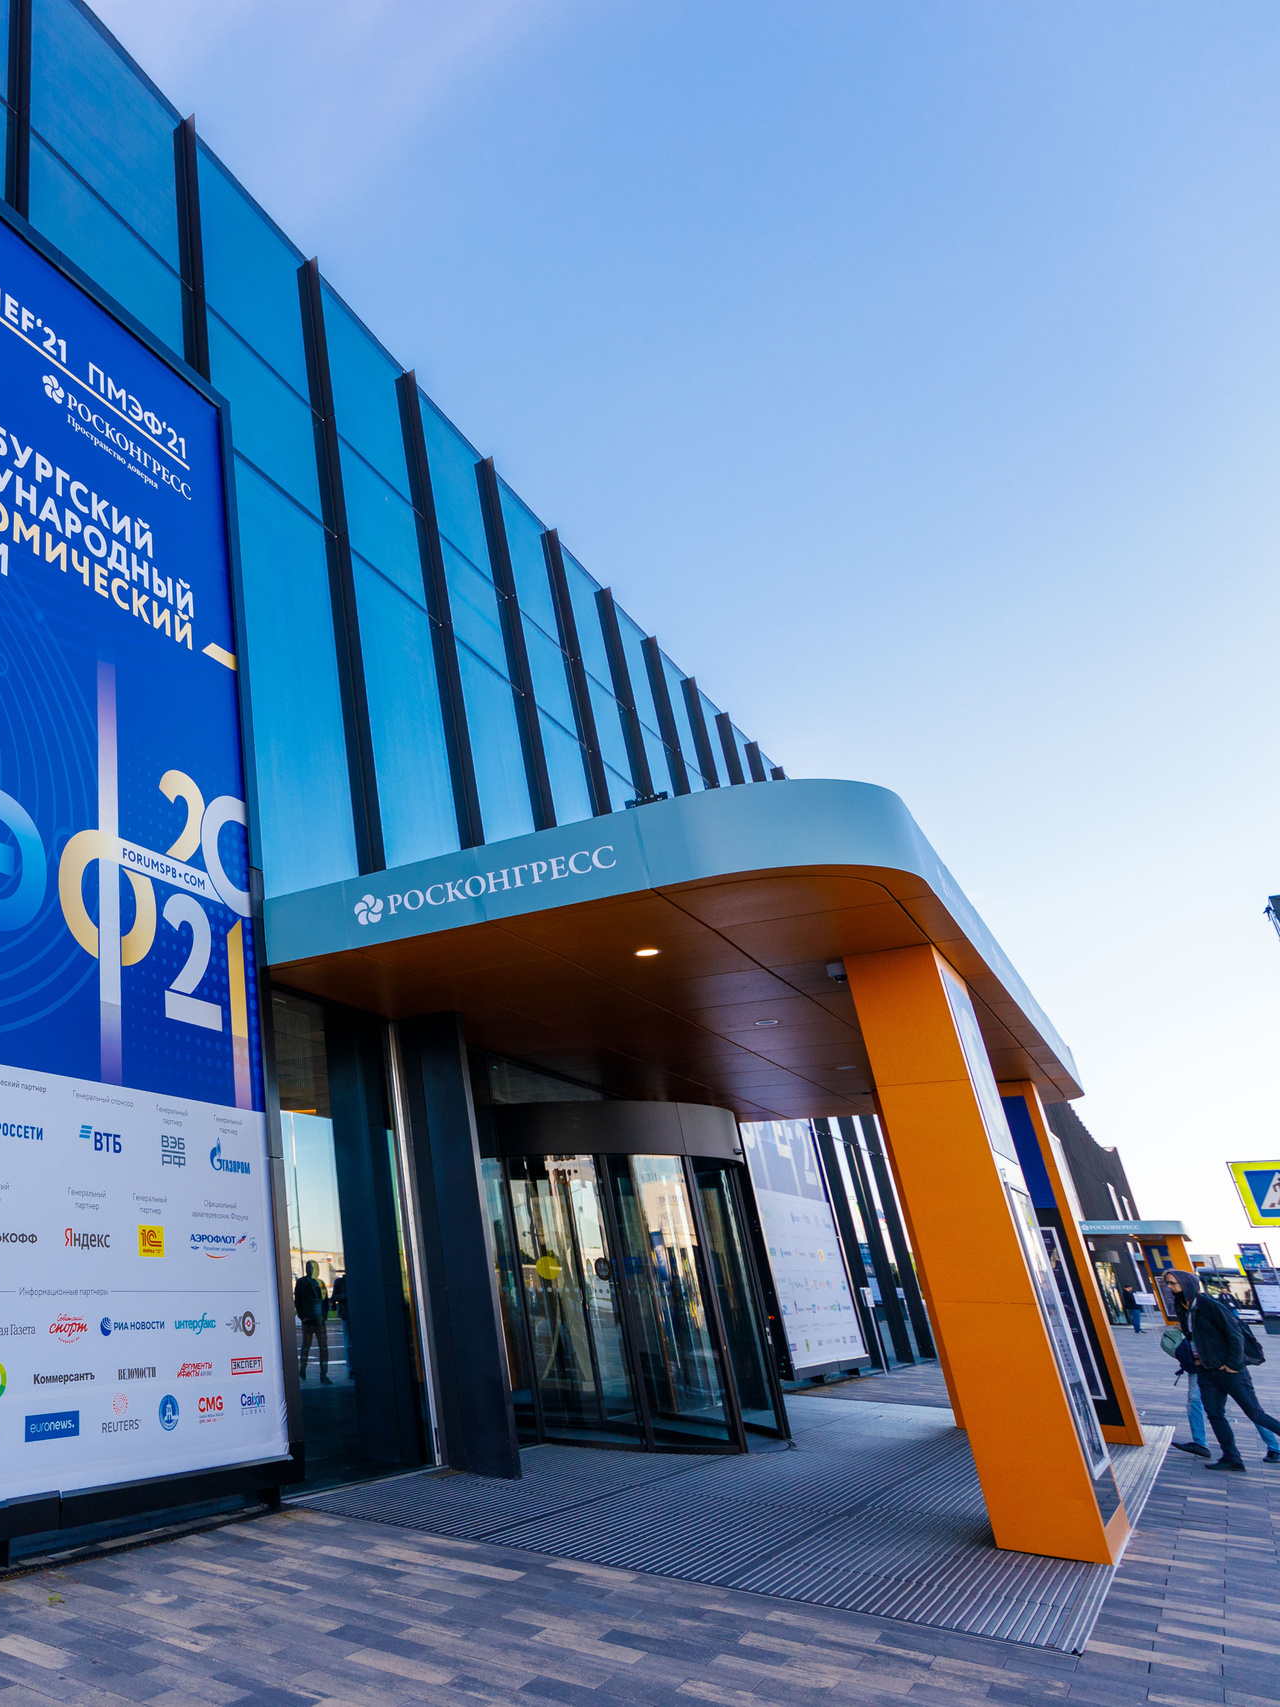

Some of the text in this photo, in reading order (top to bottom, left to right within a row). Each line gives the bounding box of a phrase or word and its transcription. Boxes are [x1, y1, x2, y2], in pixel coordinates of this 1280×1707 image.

[66, 414, 159, 490] Пространство доверия
[67, 392, 192, 501] РОСКОНГРЕСС
[388, 845, 617, 916] РОСКОНГРЕСС
[21, 1082, 47, 1094] партнер
[72, 1090, 134, 1108] Генеральный спонсор
[94, 1131, 122, 1154] ВТБ
[161, 1134, 185, 1150] ВЭБ
[221, 1157, 251, 1175] ГАЗПРОМ
[67, 1186, 107, 1199] Генеральный
[133, 1192, 168, 1204] Генеральный
[74, 1200, 100, 1212] партнер
[139, 1205, 162, 1216] партнер
[64, 1228, 110, 1250] Яндекс
[189, 1233, 237, 1245] АЭРОФЛОТ
[19, 1286, 109, 1298] Информационные партнеры
[9, 1323, 36, 1336] Газета
[113, 1320, 165, 1331] РИА НОВОСТИ
[232, 1358, 261, 1370] ЭКСПЕРТ
[33, 1372, 95, 1385] Коммерсантъ
[117, 1366, 156, 1381] ВЕДОМОСТИ
[198, 1395, 224, 1413] CMG
[240, 1391, 265, 1408] Caixin
[101, 1418, 140, 1434] REUTERS
